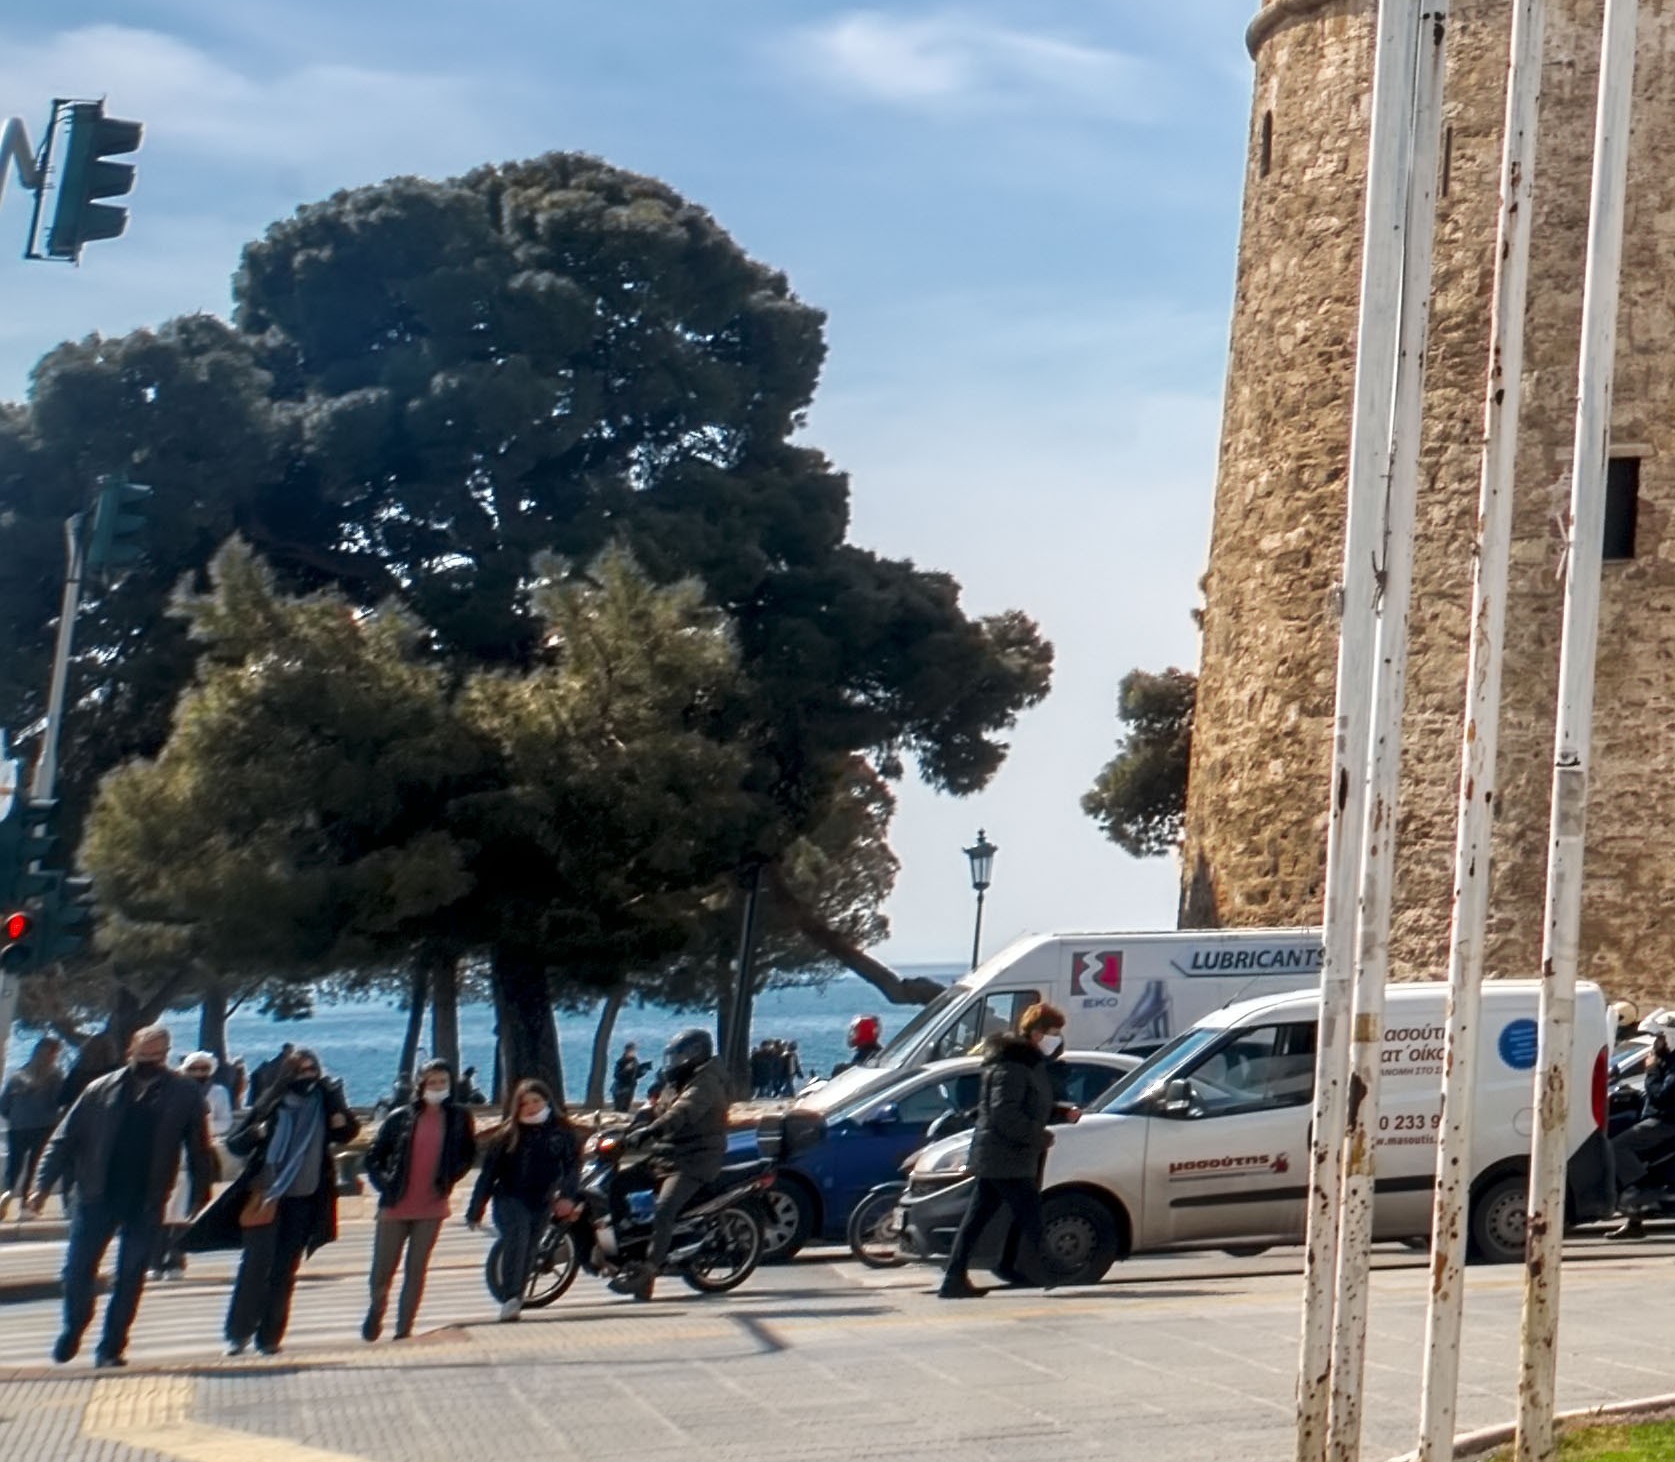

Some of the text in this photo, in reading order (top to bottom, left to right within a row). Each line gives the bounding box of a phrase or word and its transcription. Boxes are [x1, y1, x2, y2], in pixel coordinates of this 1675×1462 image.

[1191, 946, 1326, 970] LUBRICANTS
[1083, 997, 1118, 1008] EKO
[1394, 1114, 1425, 1130] 233
